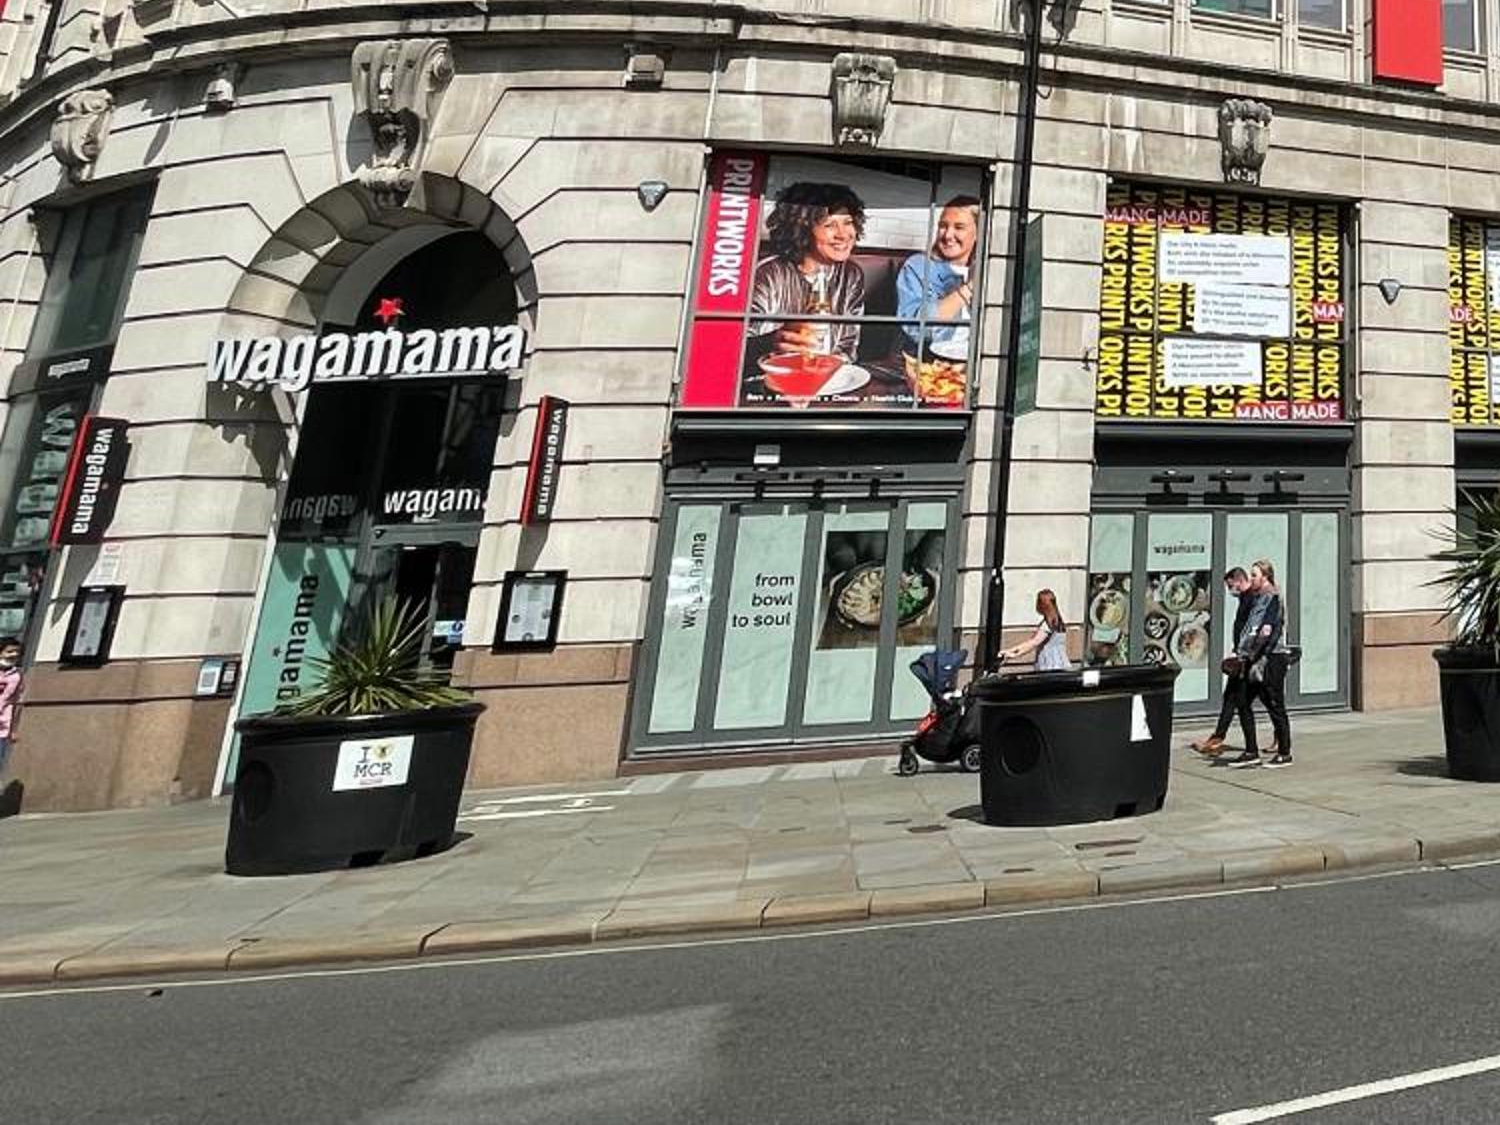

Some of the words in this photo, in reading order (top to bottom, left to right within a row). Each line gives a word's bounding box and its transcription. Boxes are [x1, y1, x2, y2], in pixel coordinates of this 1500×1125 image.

[1104, 207, 1157, 222] MANC
[1162, 210, 1212, 224] MADE
[707, 158, 756, 297] PRINTWORKS
[205, 324, 527, 392] wagamama
[1236, 404, 1288, 419] MANC
[1291, 403, 1339, 419] MADE
[537, 408, 565, 515] wagamama
[71, 427, 116, 535] wagamama
[754, 572, 796, 588] from
[751, 592, 794, 608] bowl
[731, 613, 749, 629] to
[752, 612, 792, 627] soul
[360, 746, 370, 763] I
[353, 761, 393, 779] MCR
